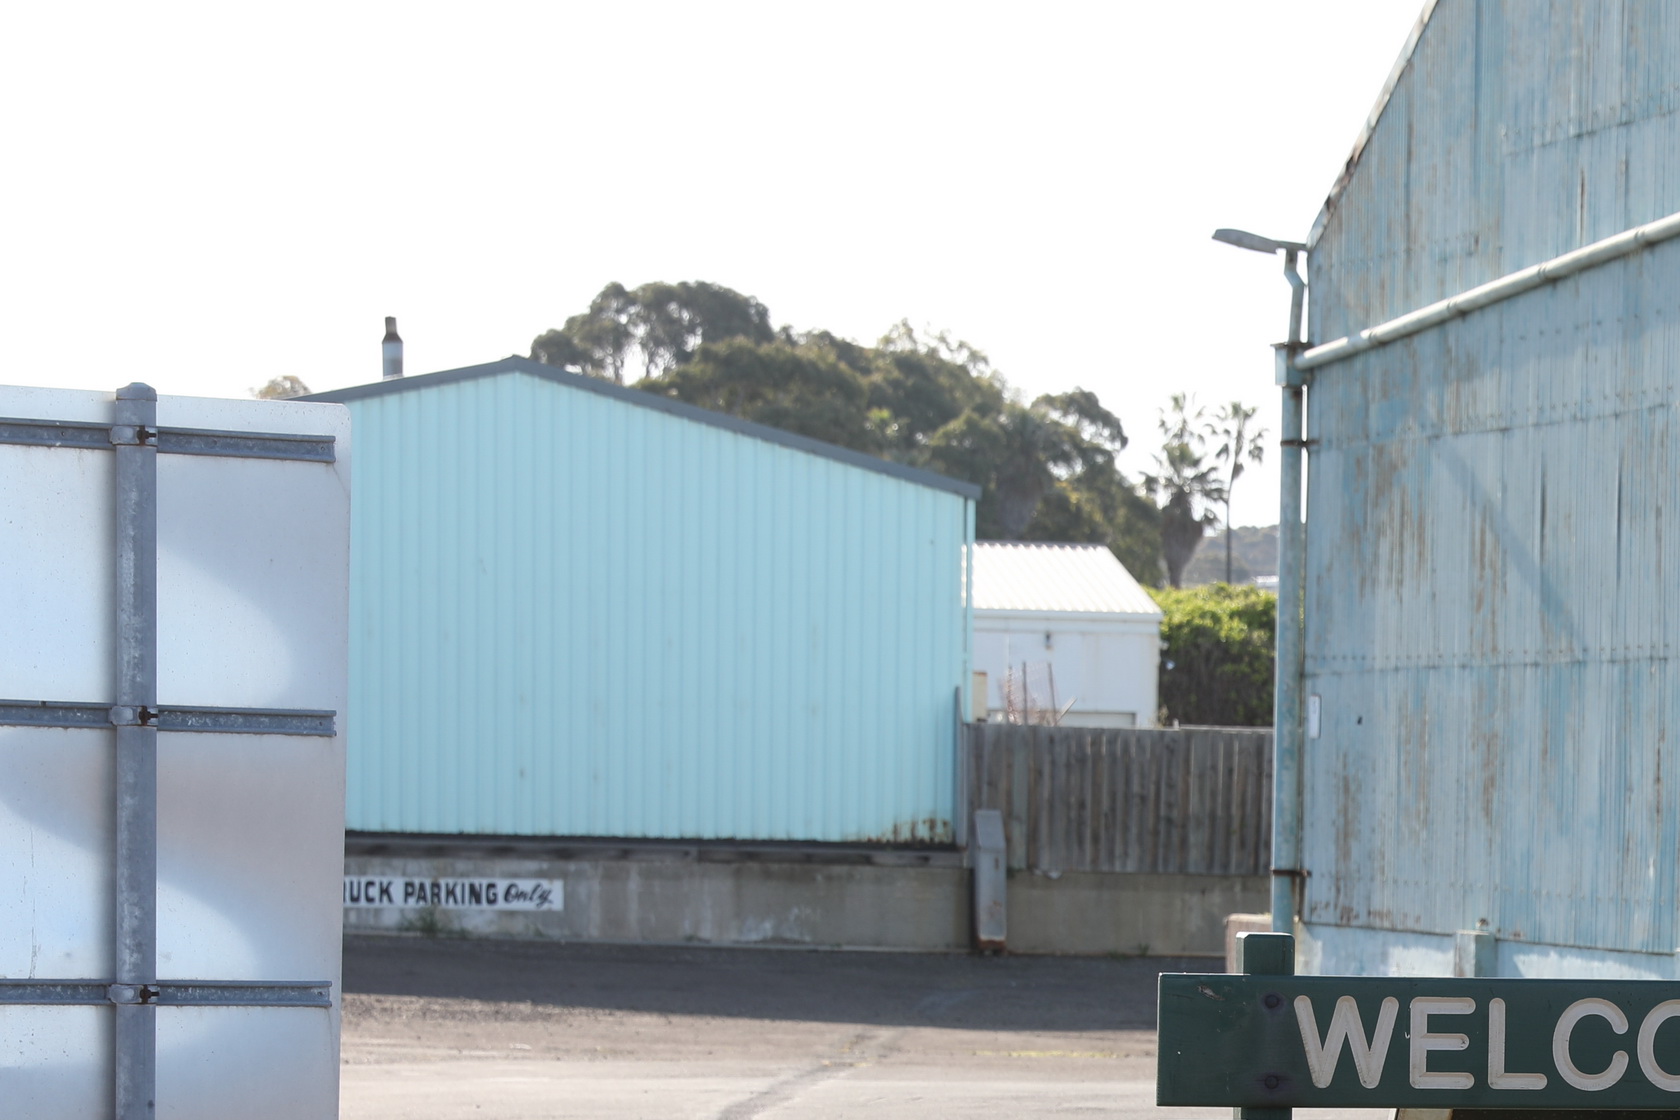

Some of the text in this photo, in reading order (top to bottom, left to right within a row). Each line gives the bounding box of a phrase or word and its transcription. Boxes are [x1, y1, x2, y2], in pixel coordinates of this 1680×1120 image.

[343, 881, 554, 908] UCK PARKING Only
